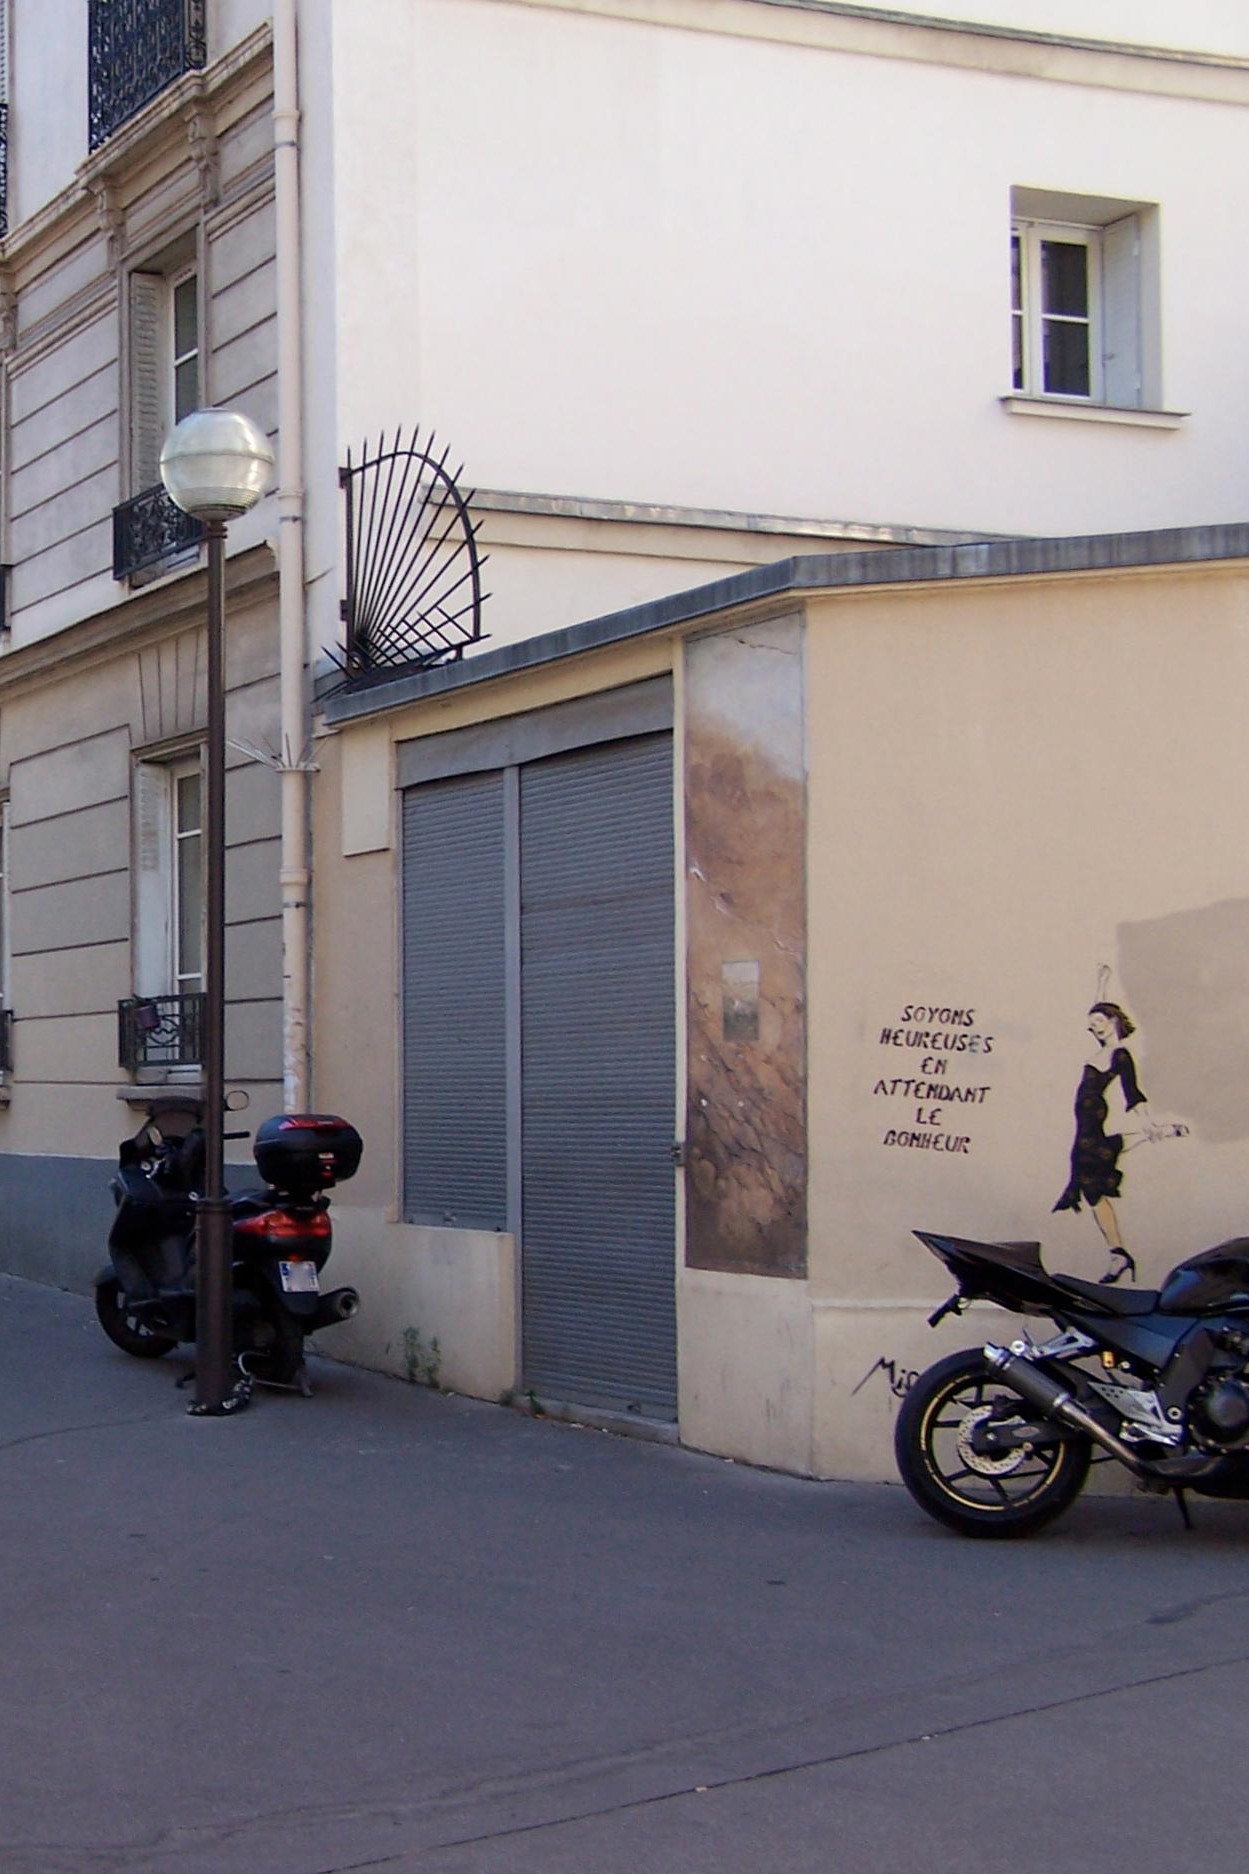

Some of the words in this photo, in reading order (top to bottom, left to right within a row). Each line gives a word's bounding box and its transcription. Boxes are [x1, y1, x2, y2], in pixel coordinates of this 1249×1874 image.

[901, 1004, 976, 1027] SOYONS
[879, 1027, 994, 1054] HEUREUSES
[920, 1056, 948, 1075] EN
[873, 1078, 992, 1104] ATTENDANT
[915, 1107, 943, 1126] LE
[883, 1129, 971, 1154] BONHEUR
